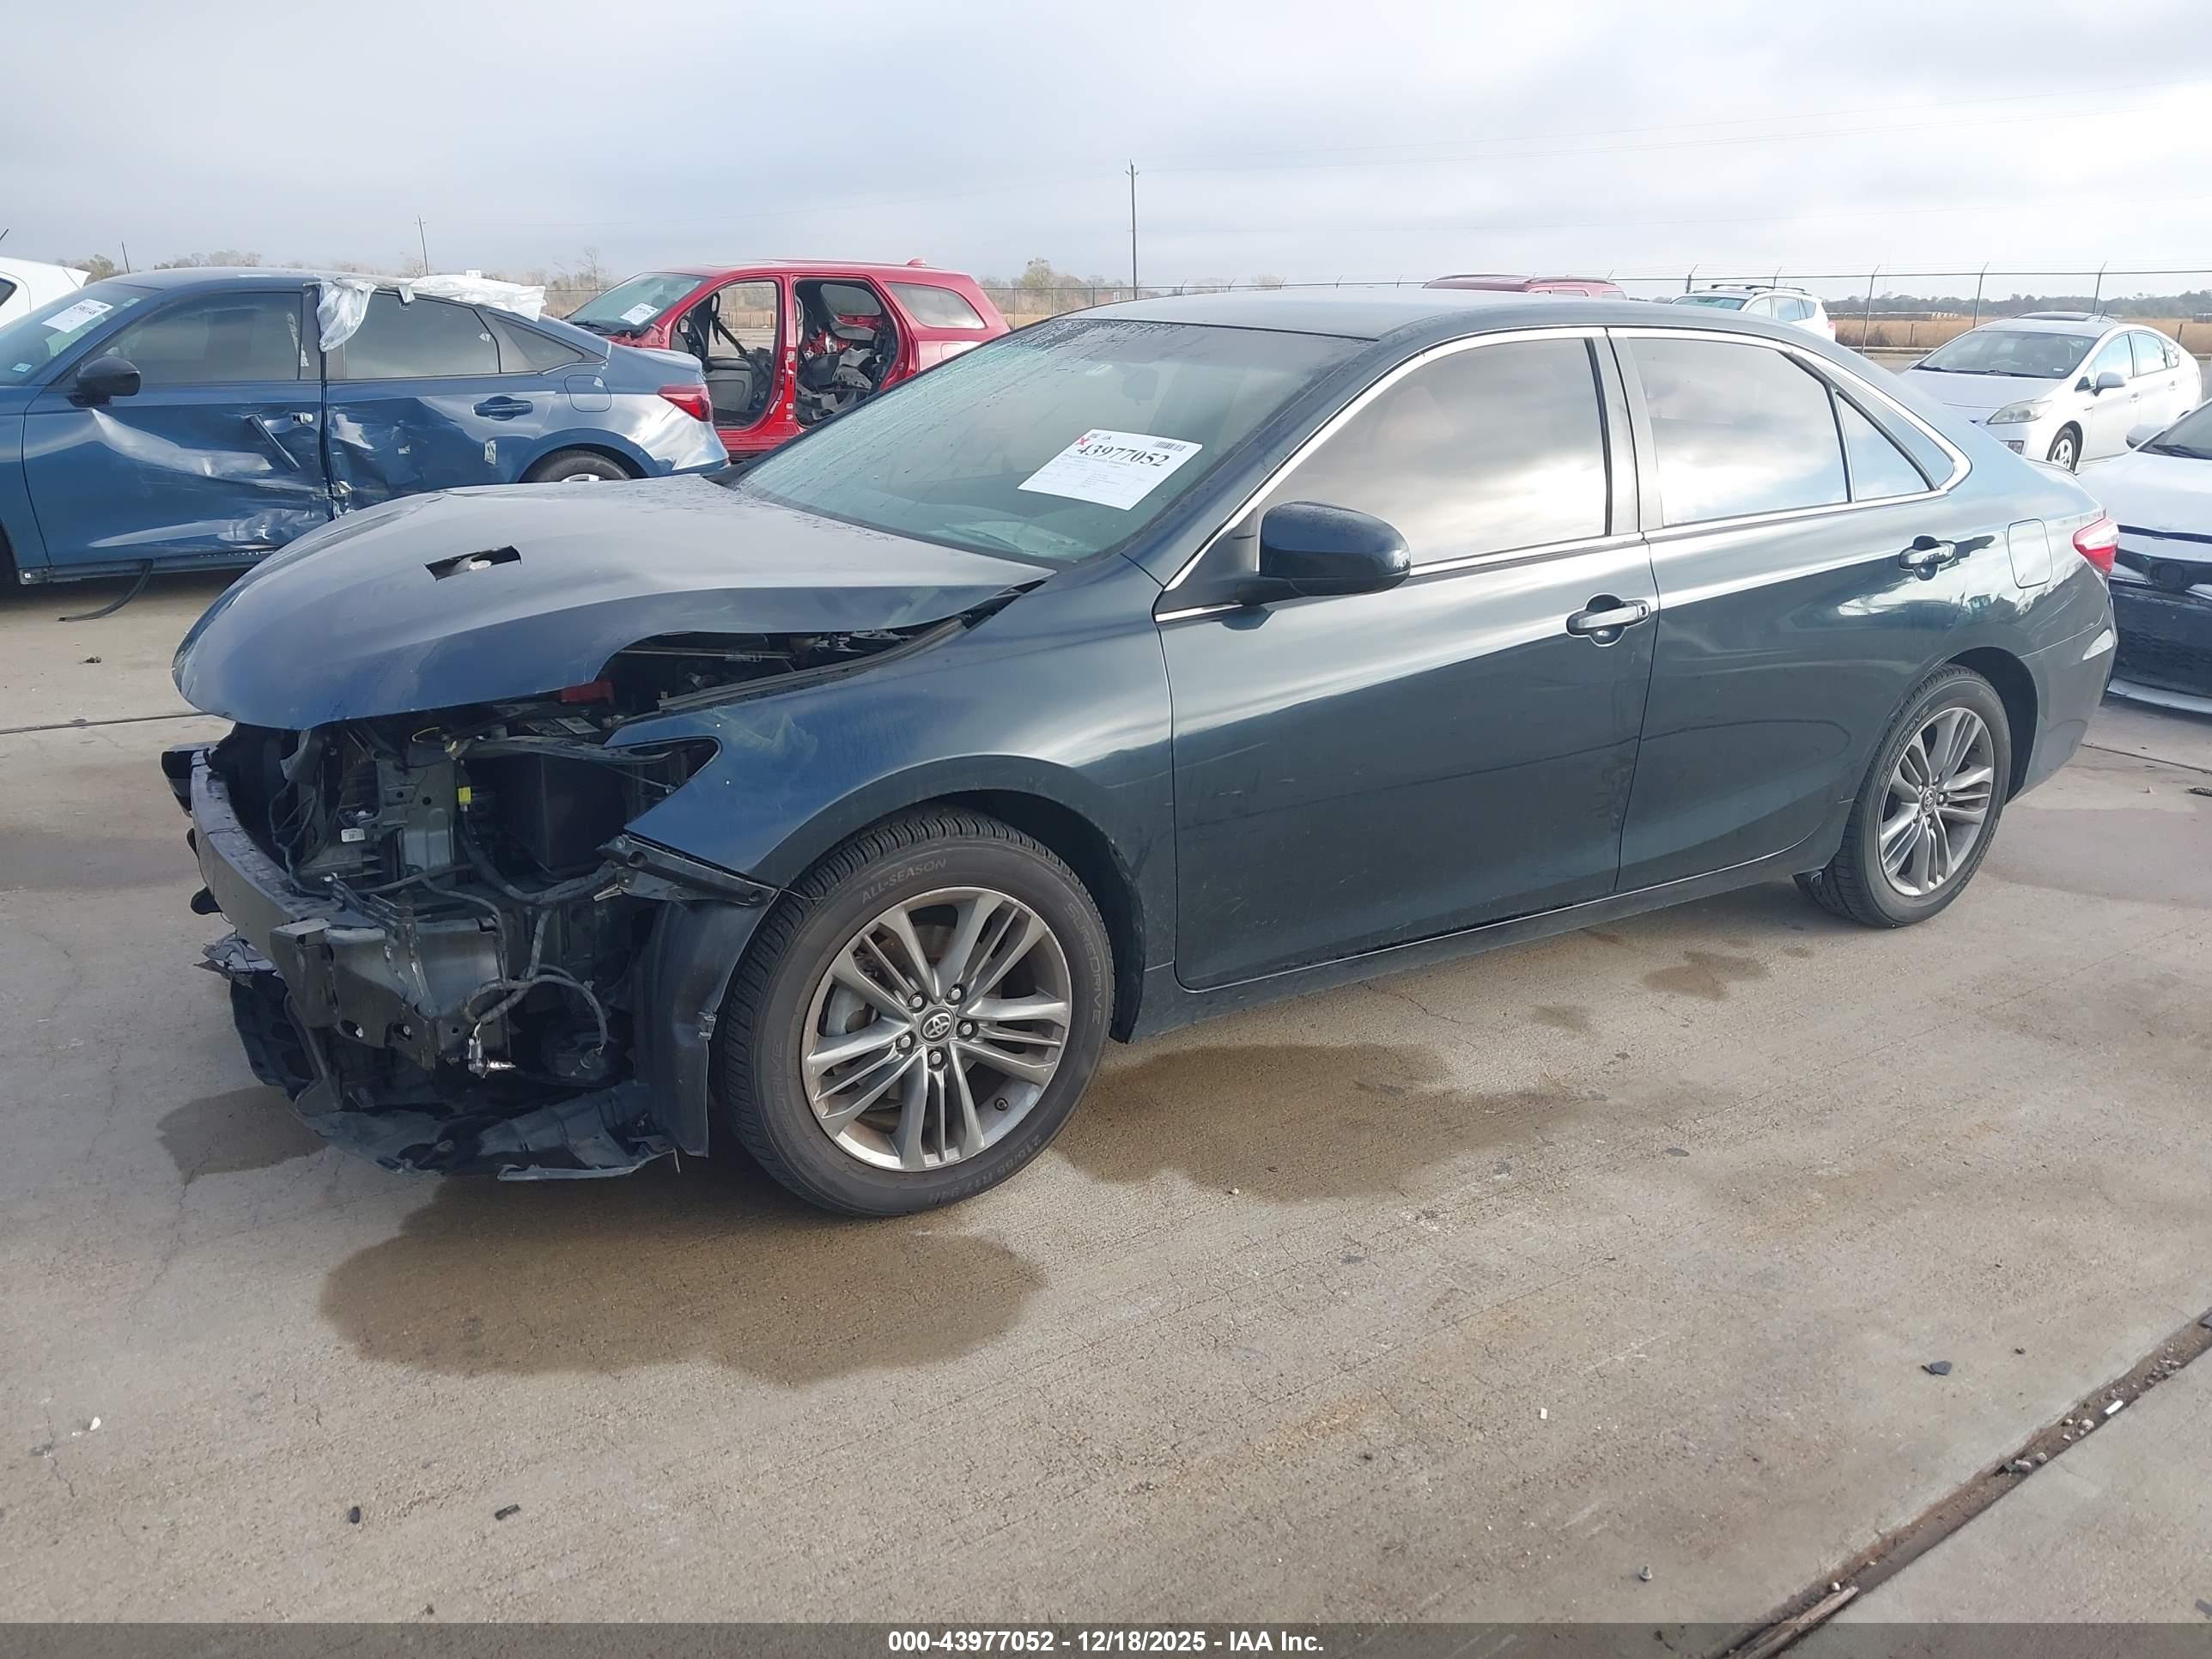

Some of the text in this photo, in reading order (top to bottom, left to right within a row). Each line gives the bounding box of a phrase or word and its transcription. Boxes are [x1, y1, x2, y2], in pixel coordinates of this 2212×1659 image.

[1077, 444, 1170, 467] 43977052
[861, 857, 947, 904] ALL-SEASON
[1065, 902, 1103, 1025] SUREDRIVE
